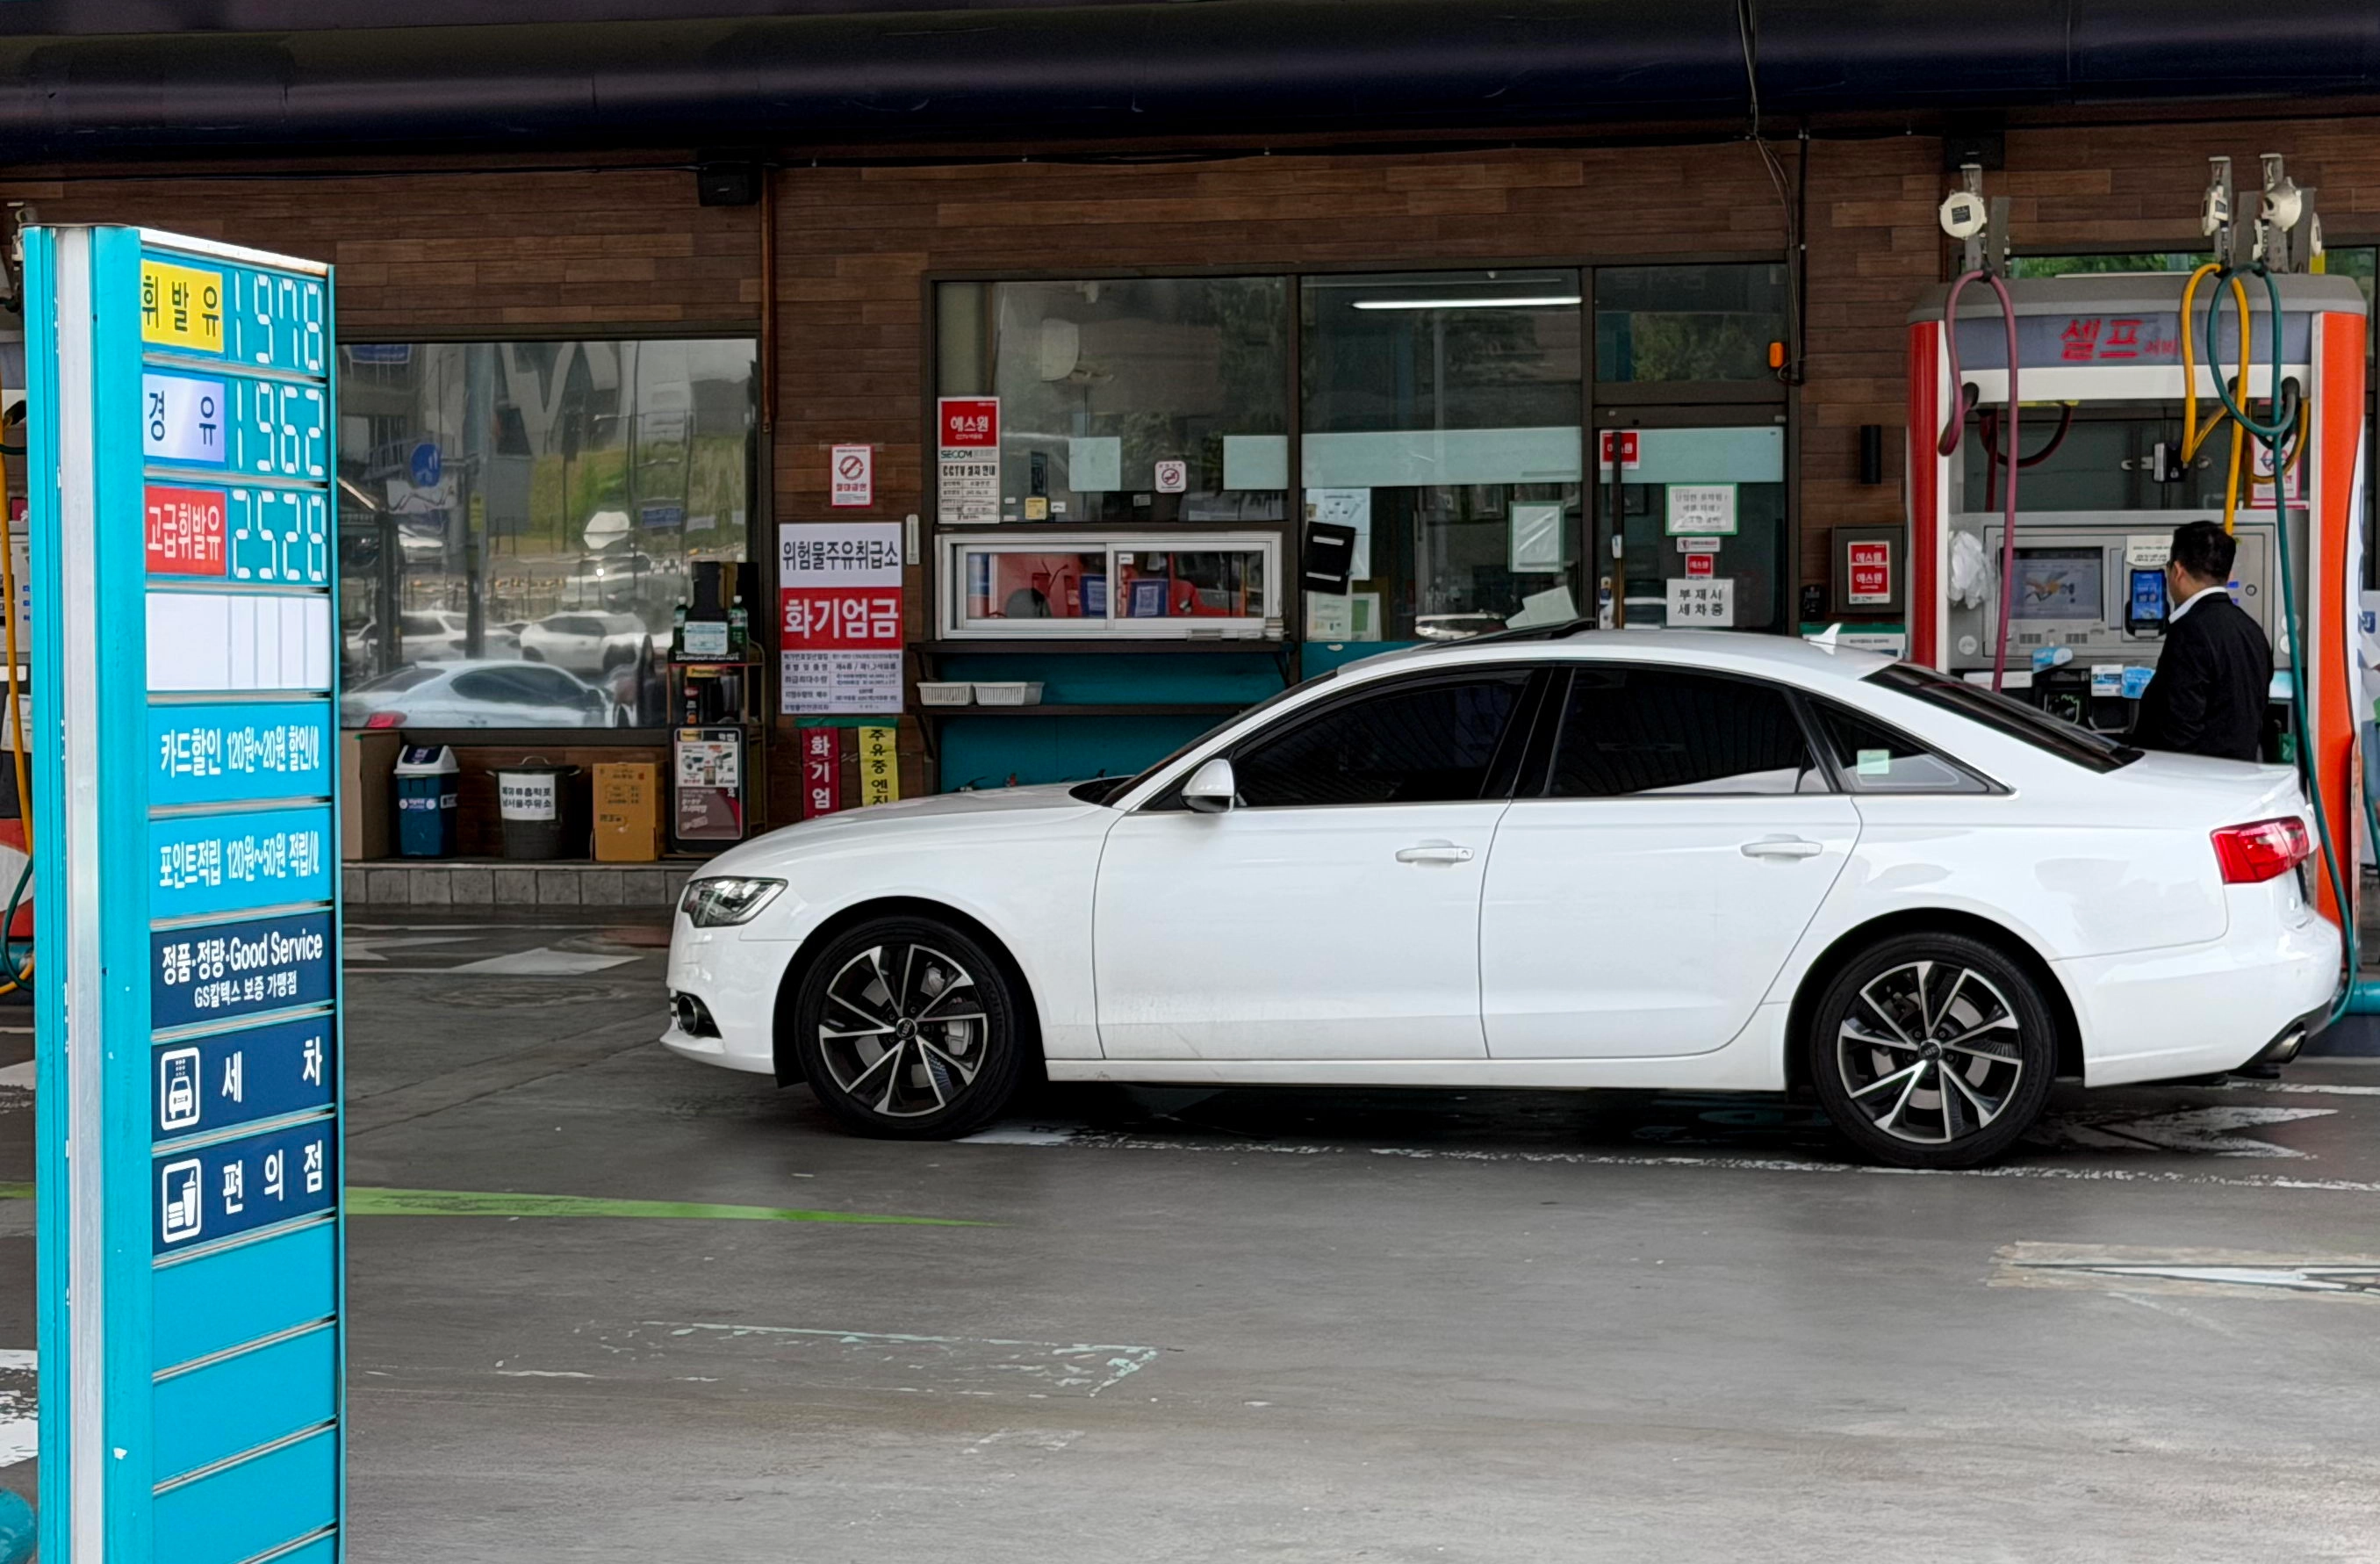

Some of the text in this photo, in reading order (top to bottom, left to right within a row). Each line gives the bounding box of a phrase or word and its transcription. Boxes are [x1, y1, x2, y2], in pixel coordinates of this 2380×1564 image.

[142, 270, 323, 371] 휘발유 1978
[2060, 319, 2144, 361] 셀프
[148, 380, 325, 476] 경유 1962
[950, 415, 989, 432] 에스원
[941, 450, 972, 459] SECOM
[943, 465, 965, 476] CCTV
[147, 489, 327, 581] 고급휘발유 2528
[783, 540, 898, 571] 위험물주유취급소
[784, 598, 898, 639] 화기엄금
[161, 727, 221, 779] 카드할인
[810, 735, 830, 818] 화기엄
[160, 838, 221, 889] 포인트적립
[270, 928, 323, 966] Service
[194, 970, 298, 1009] GS칼텍스 보증 가맹점
